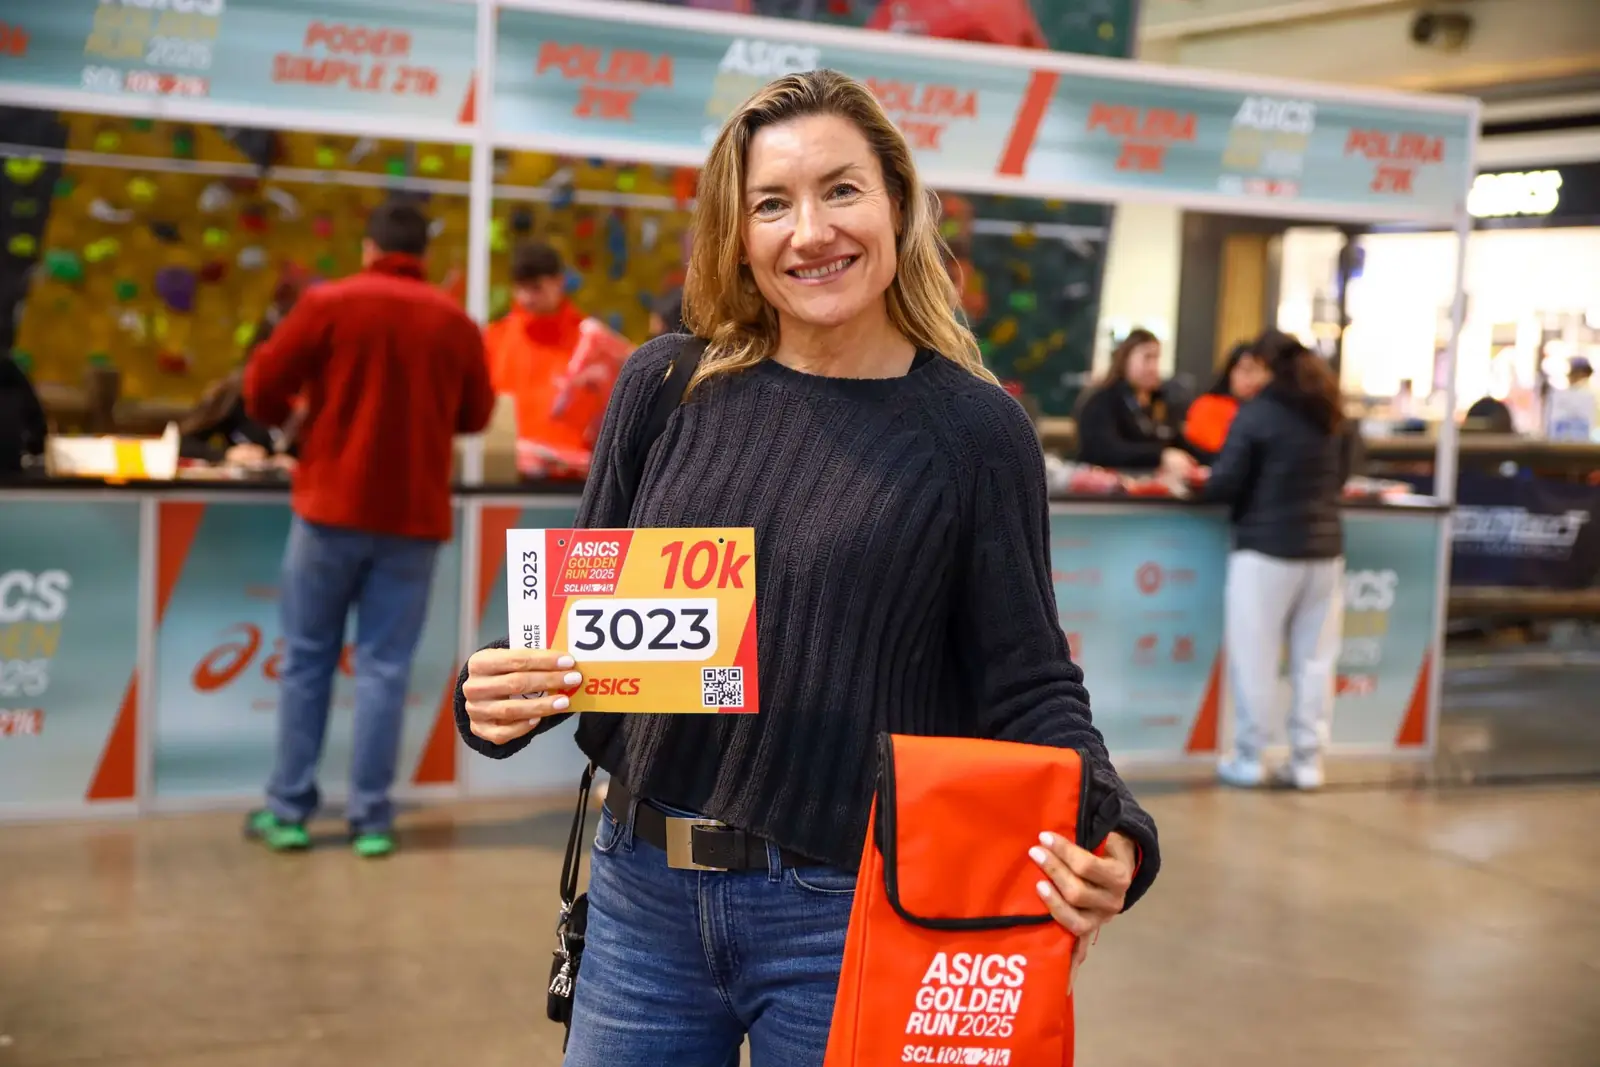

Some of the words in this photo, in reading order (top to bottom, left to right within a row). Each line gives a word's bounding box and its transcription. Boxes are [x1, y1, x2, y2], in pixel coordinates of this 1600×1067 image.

[536, 40, 674, 88] POLERA
[1085, 101, 1198, 143] POLERA
[1343, 127, 1446, 165] POLERA
[571, 541, 620, 557] ASICS
[523, 551, 538, 600] 3023
[565, 569, 588, 580] RUN
[589, 568, 615, 579] 2025
[568, 557, 618, 569] GOLDEN
[660, 540, 752, 590] 10k
[523, 624, 533, 649] ACE
[574, 608, 711, 651] 3023
[584, 678, 641, 696] asics
[921, 952, 1027, 987] ASICS
[915, 986, 1023, 1013] GOLDEN
[905, 1012, 958, 1036] RUN
[958, 1014, 1016, 1038] 2025
[901, 1044, 937, 1064] SCL
